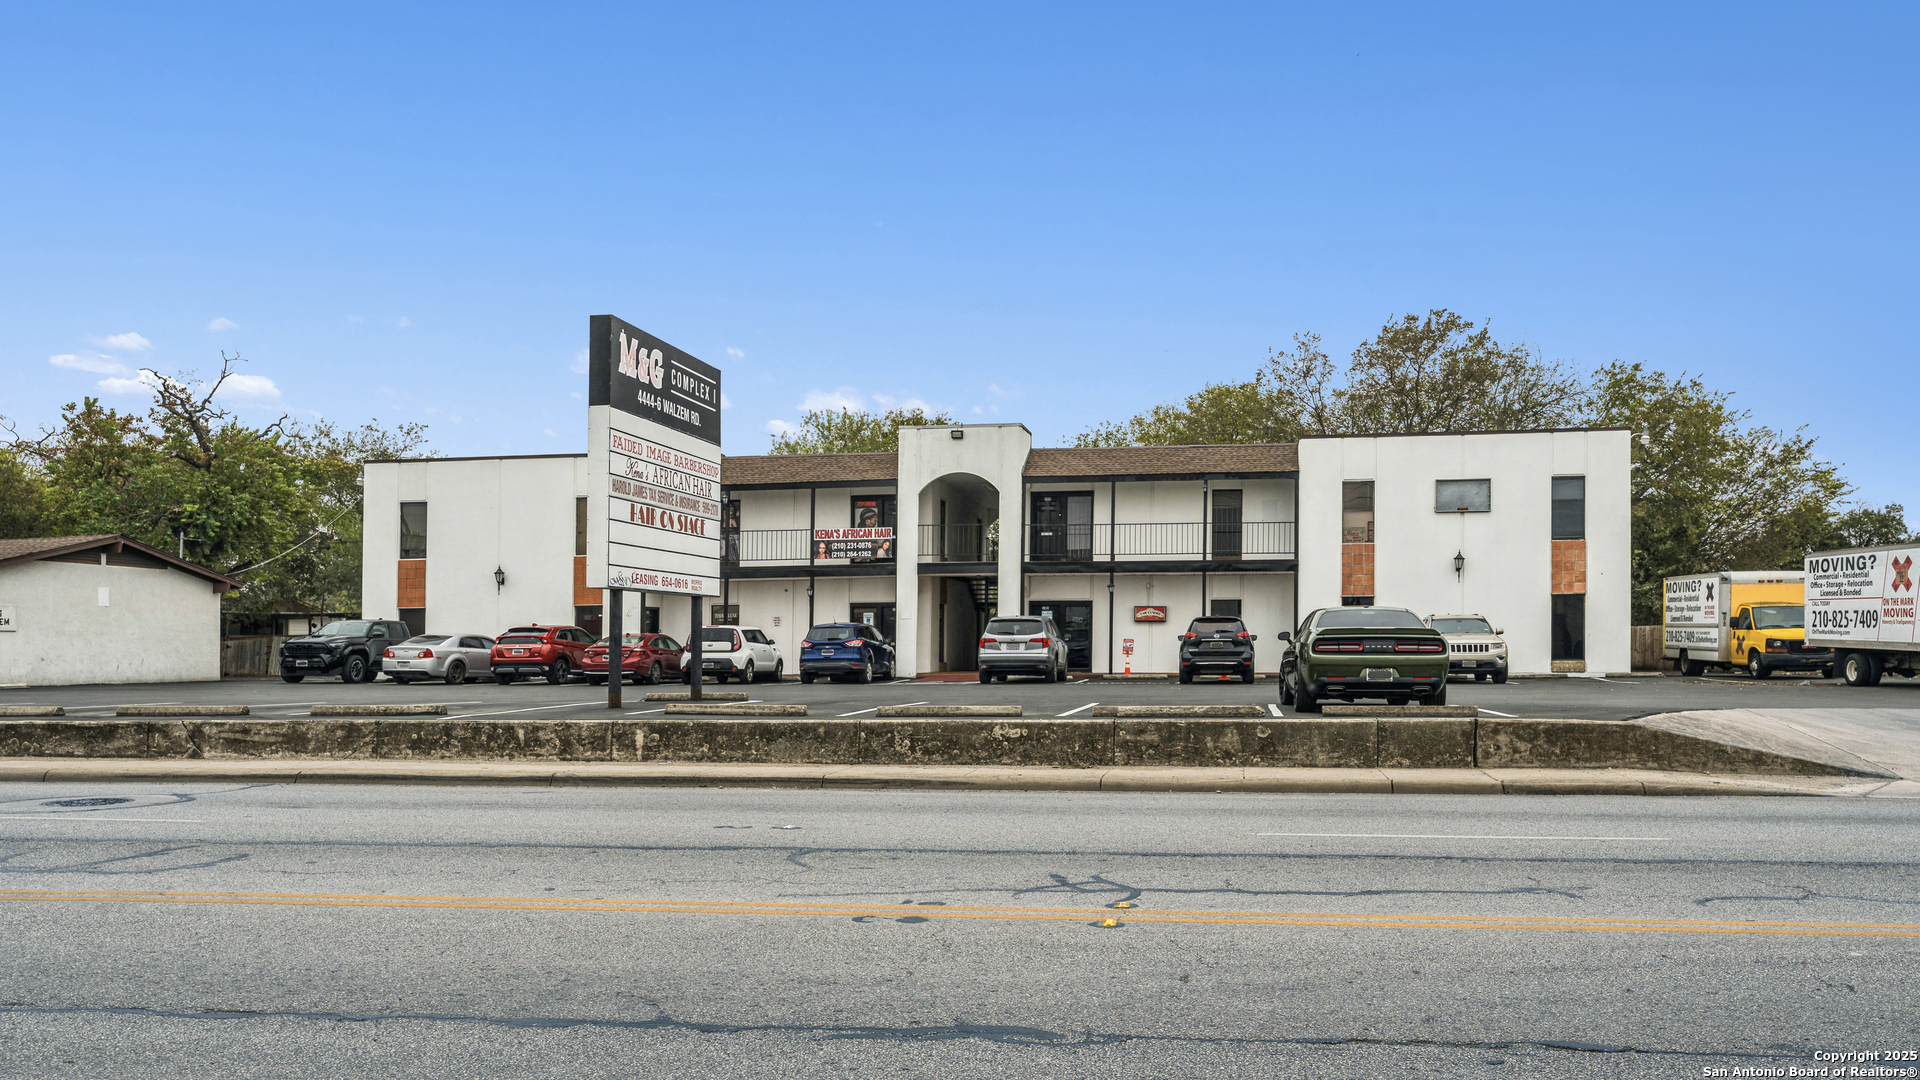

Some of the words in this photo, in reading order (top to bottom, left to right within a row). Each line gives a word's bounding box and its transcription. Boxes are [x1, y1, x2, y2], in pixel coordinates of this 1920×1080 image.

[618, 329, 664, 389] M&G
[671, 369, 710, 401] COMPLEX
[638, 390, 662, 411] 4444-6
[662, 398, 690, 422] WALZEM
[690, 410, 701, 426] RD.
[612, 434, 643, 456] FAIDED
[646, 445, 671, 464] IMAGE
[674, 454, 719, 478] BARBERSHOP
[625, 458, 649, 481] Kena's
[652, 467, 691, 492] AFRICAN
[692, 478, 712, 498] HAIR
[612, 478, 631, 496] HAROLD
[632, 484, 648, 500] JAMES
[657, 490, 674, 507] SERVICE
[675, 495, 679, 507] &
[680, 496, 700, 512] INSURANCE
[630, 503, 656, 526] HAIR
[660, 510, 674, 530] ON
[677, 514, 705, 536] STAGE
[815, 529, 840, 539] KENA'S
[842, 529, 872, 539] AFRICAN
[874, 528, 891, 538] HAIR
[1809, 554, 1876, 574] MOVING?
[632, 572, 658, 586] LEASING
[661, 576, 688, 589] 654-0616
[1666, 580, 1702, 593] MOVING?
[1826, 581, 1844, 589] Storage
[1883, 598, 1889, 606] ON
[1891, 598, 1899, 606] THE
[1900, 597, 1914, 606] MARK
[1812, 610, 1878, 628] 210-825-7409
[1883, 608, 1914, 618] MOVING
